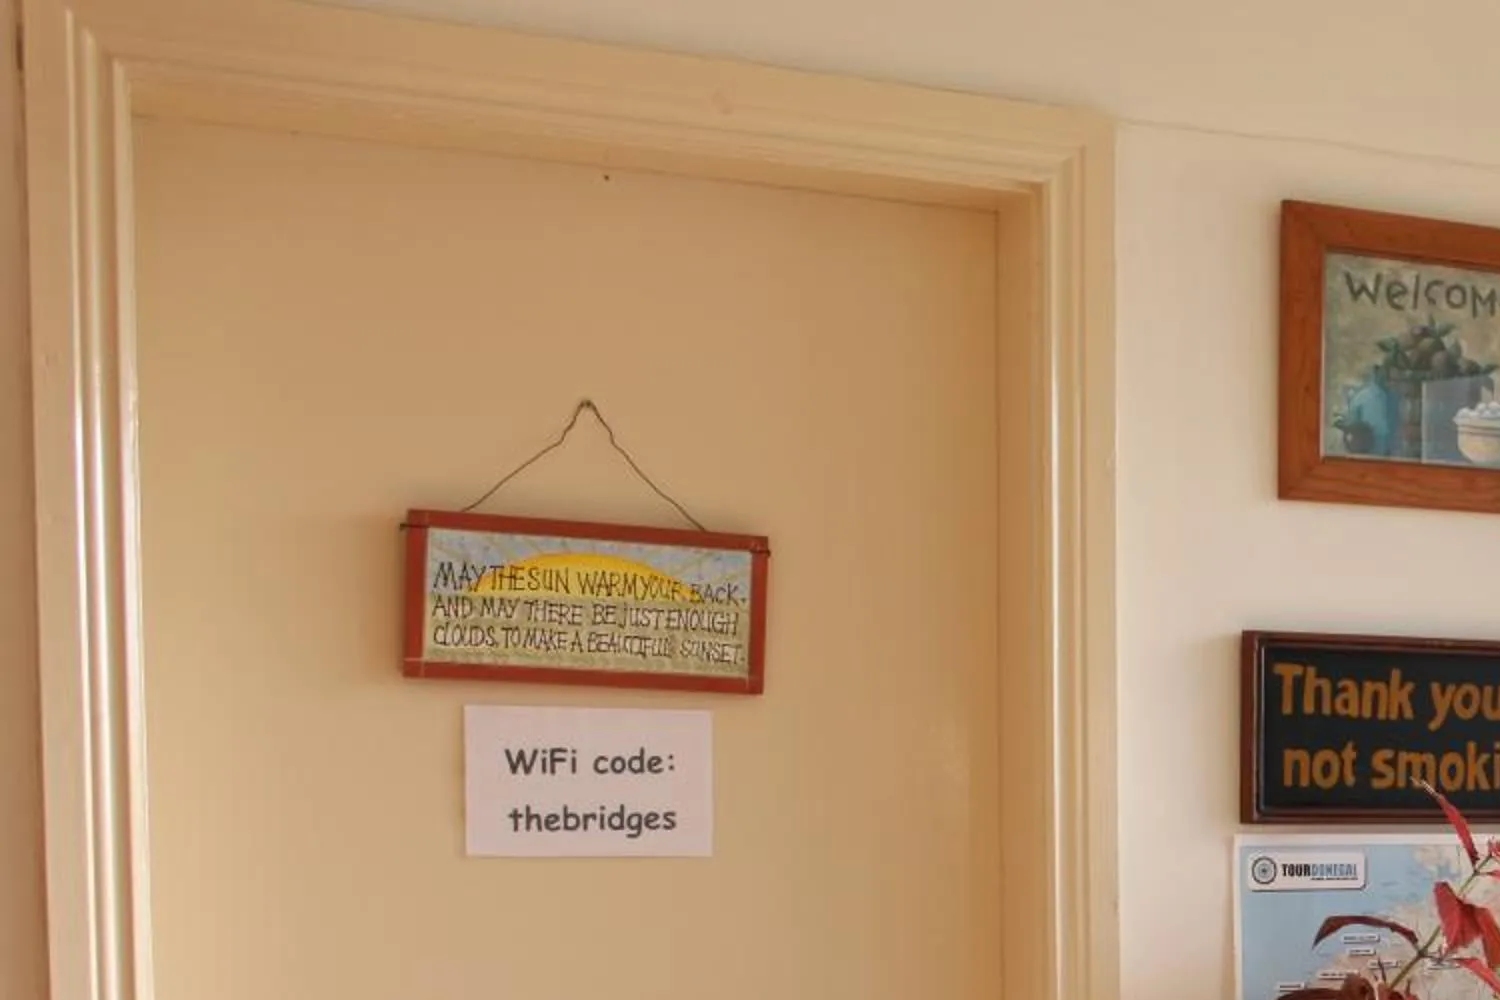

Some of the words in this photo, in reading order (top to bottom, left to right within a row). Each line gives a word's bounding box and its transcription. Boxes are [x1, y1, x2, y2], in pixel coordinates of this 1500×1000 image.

[432, 560, 487, 592] MAY
[576, 570, 638, 600] WARM
[431, 593, 473, 619] AND
[479, 595, 521, 619] MAY
[523, 599, 584, 626] THERE
[591, 602, 617, 626] BE
[665, 607, 740, 636] ENOUGH
[523, 626, 568, 652] MAKE
[569, 629, 584, 653] A
[1272, 662, 1417, 720] Thank
[503, 747, 578, 776] WiFi
[592, 747, 675, 776] code:
[1282, 740, 1359, 788] not
[507, 804, 677, 839] thebridges
